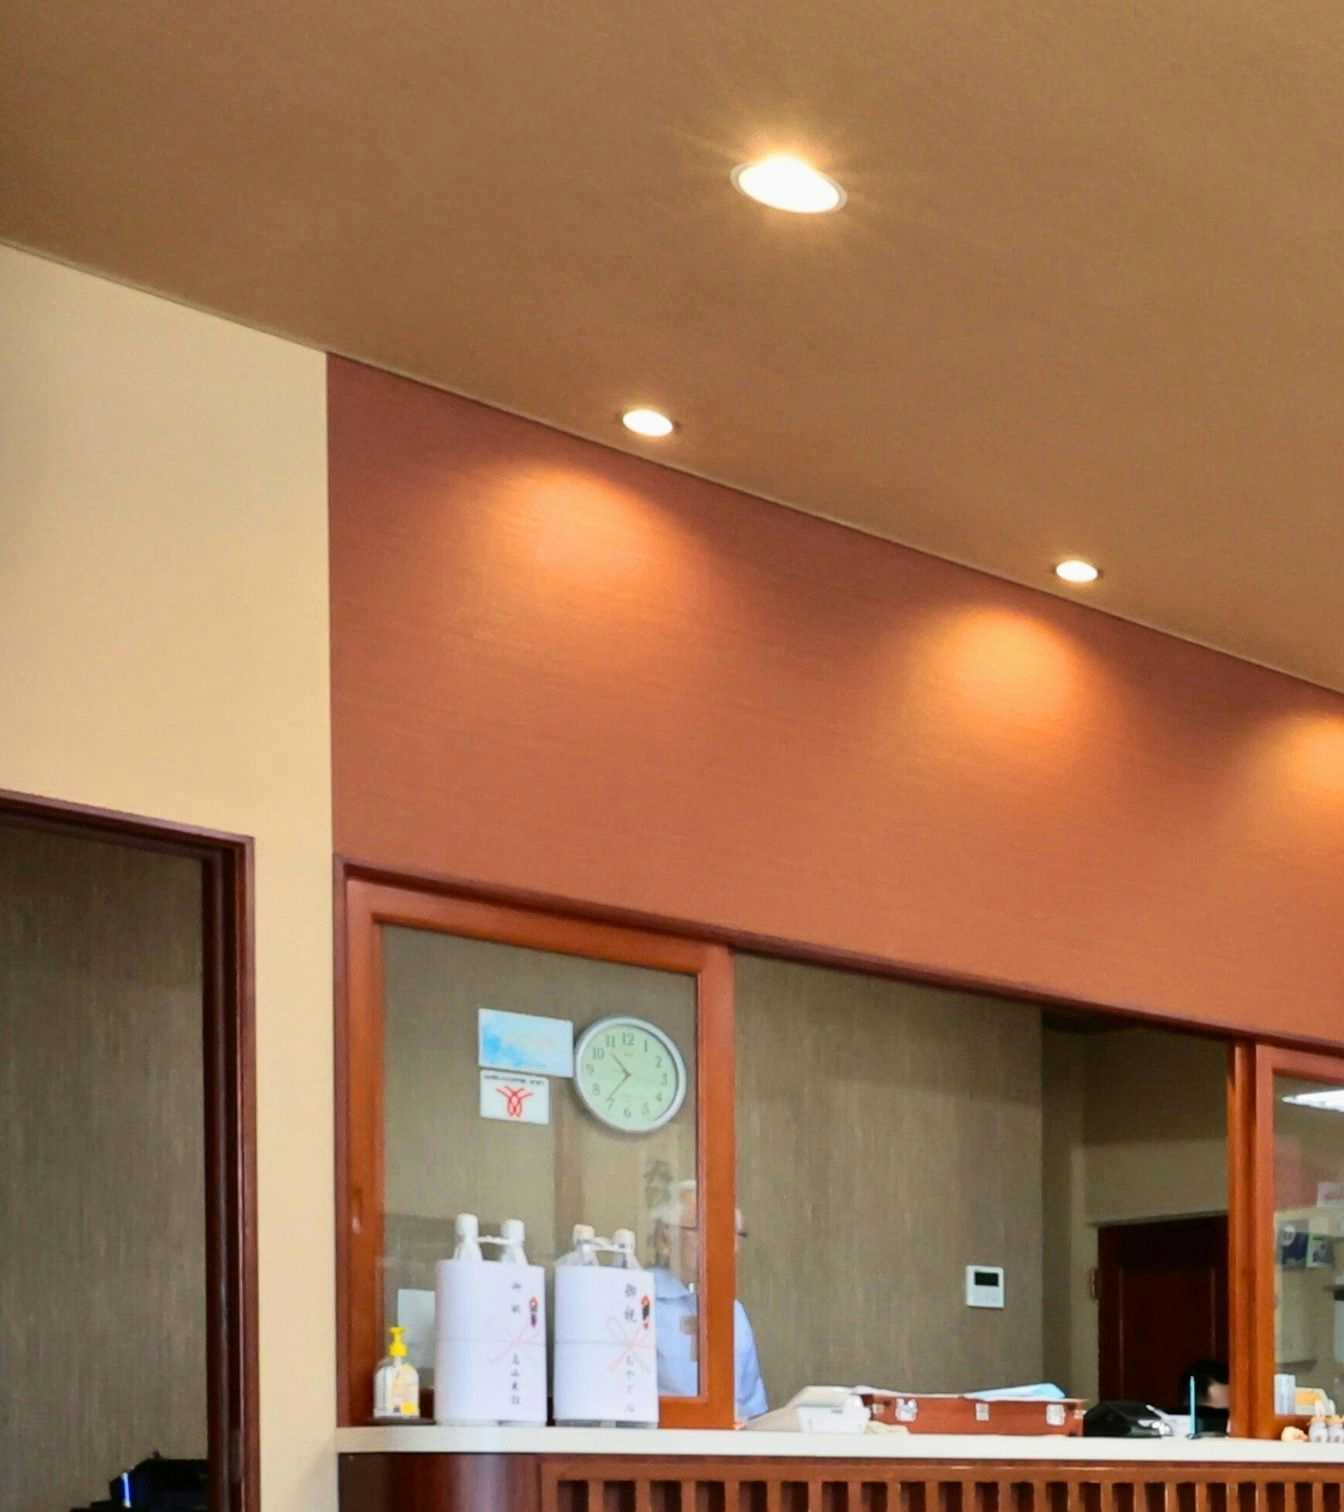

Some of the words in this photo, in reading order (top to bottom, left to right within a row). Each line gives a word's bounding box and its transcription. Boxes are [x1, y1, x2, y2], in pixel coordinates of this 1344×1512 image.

[606, 1035, 616, 1049] 11
[622, 1032, 635, 1046] 12
[643, 1040, 649, 1053] 1
[592, 1047, 605, 1060] 10
